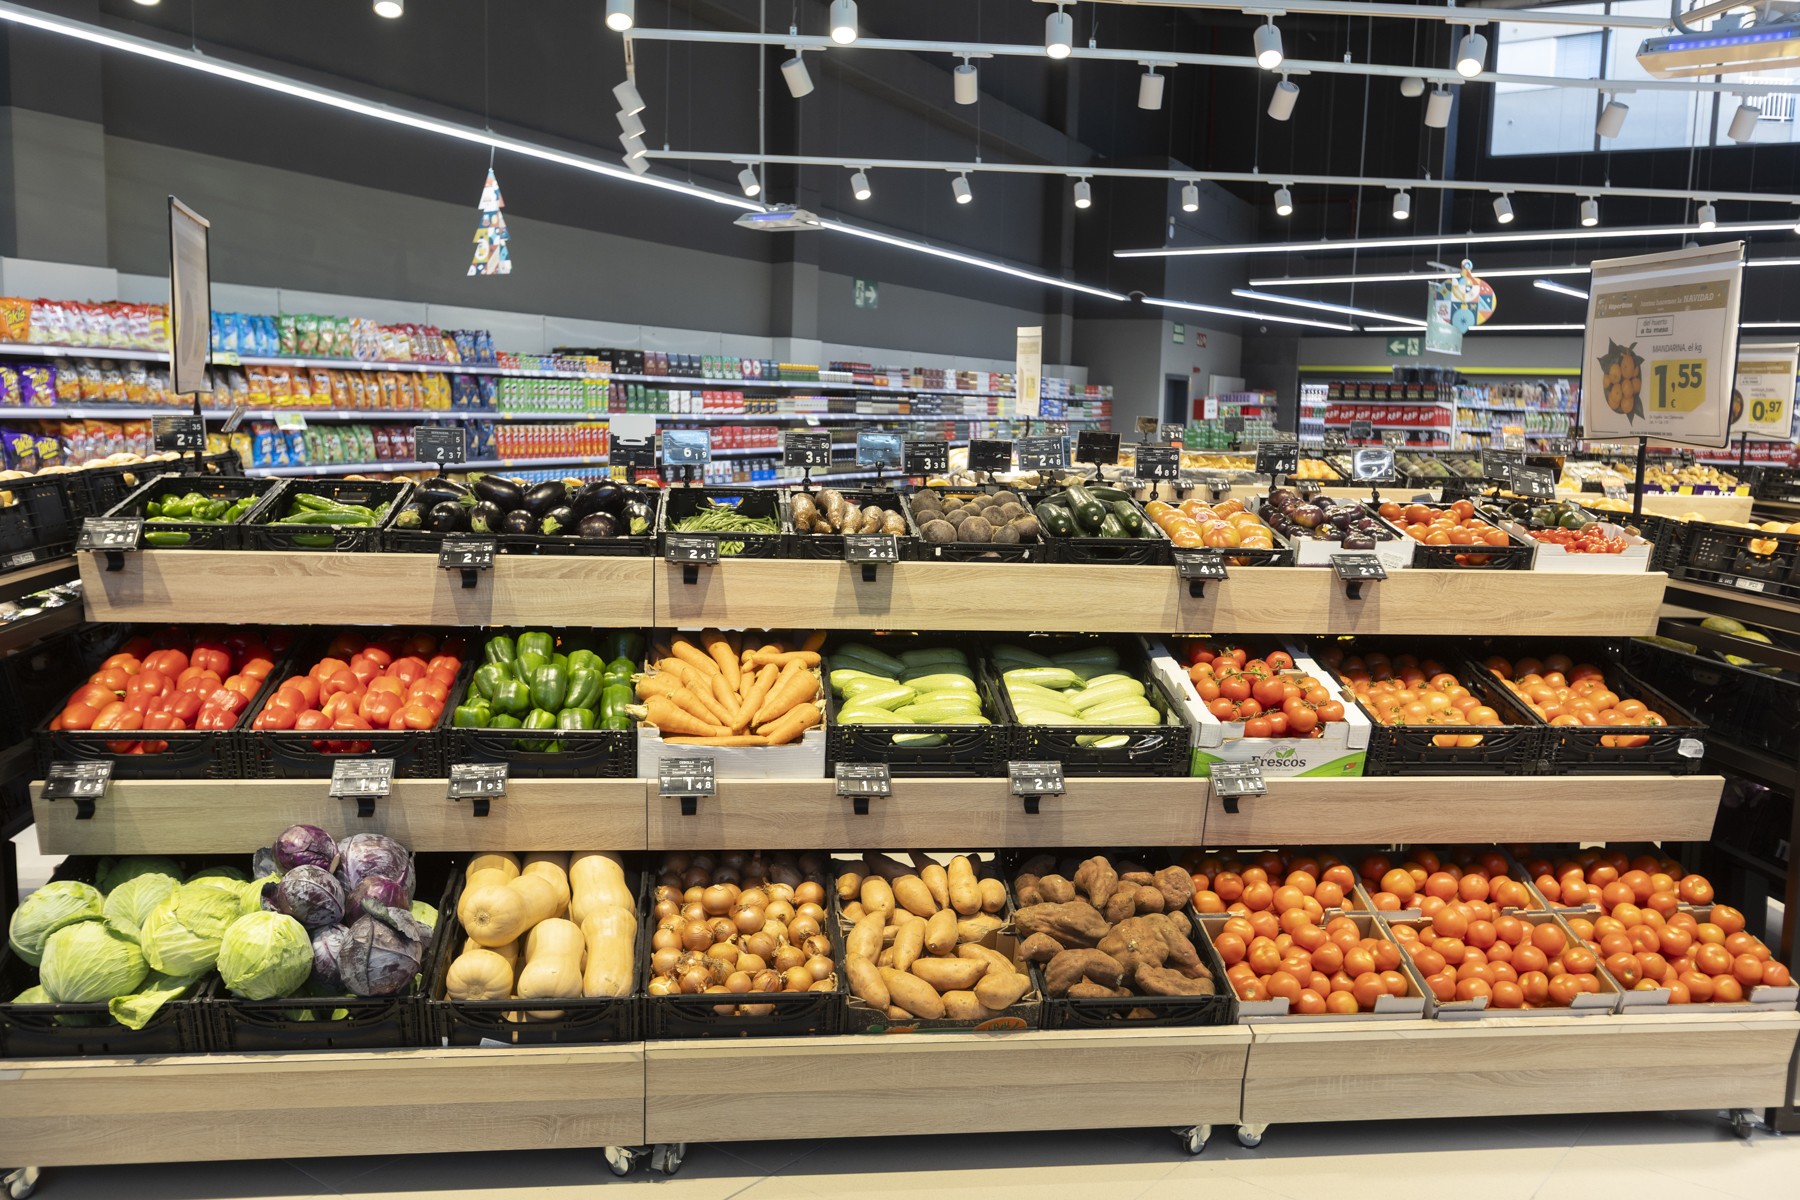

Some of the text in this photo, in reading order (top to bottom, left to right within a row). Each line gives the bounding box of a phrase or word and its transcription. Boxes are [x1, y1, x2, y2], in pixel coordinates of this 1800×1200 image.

[1684, 292, 1714, 303] NAVIDAD
[1695, 344, 1702, 353] kg
[1671, 399, 1676, 408] €
[177, 434, 185, 445] 2
[437, 447, 444, 459] 2
[684, 448, 691, 457] 6
[806, 451, 813, 463] 3
[924, 458, 931, 470] 3
[1039, 455, 1046, 466] 2
[1275, 460, 1283, 471] 4
[1155, 465, 1162, 476] 4
[1502, 466, 1509, 476] 2
[1532, 482, 1539, 493] 5
[104, 533, 116, 544] 2
[463, 553, 472, 563] 2
[690, 550, 697, 559] 2
[869, 548, 877, 557] 2
[1201, 565, 1209, 574] 4
[1359, 567, 1369, 575] 2
[74, 780, 82, 792] 1
[476, 780, 482, 791] 1
[687, 778, 692, 790] 1
[862, 780, 867, 791] 1
[1034, 778, 1043, 789] 2
[1237, 780, 1244, 791] 1
